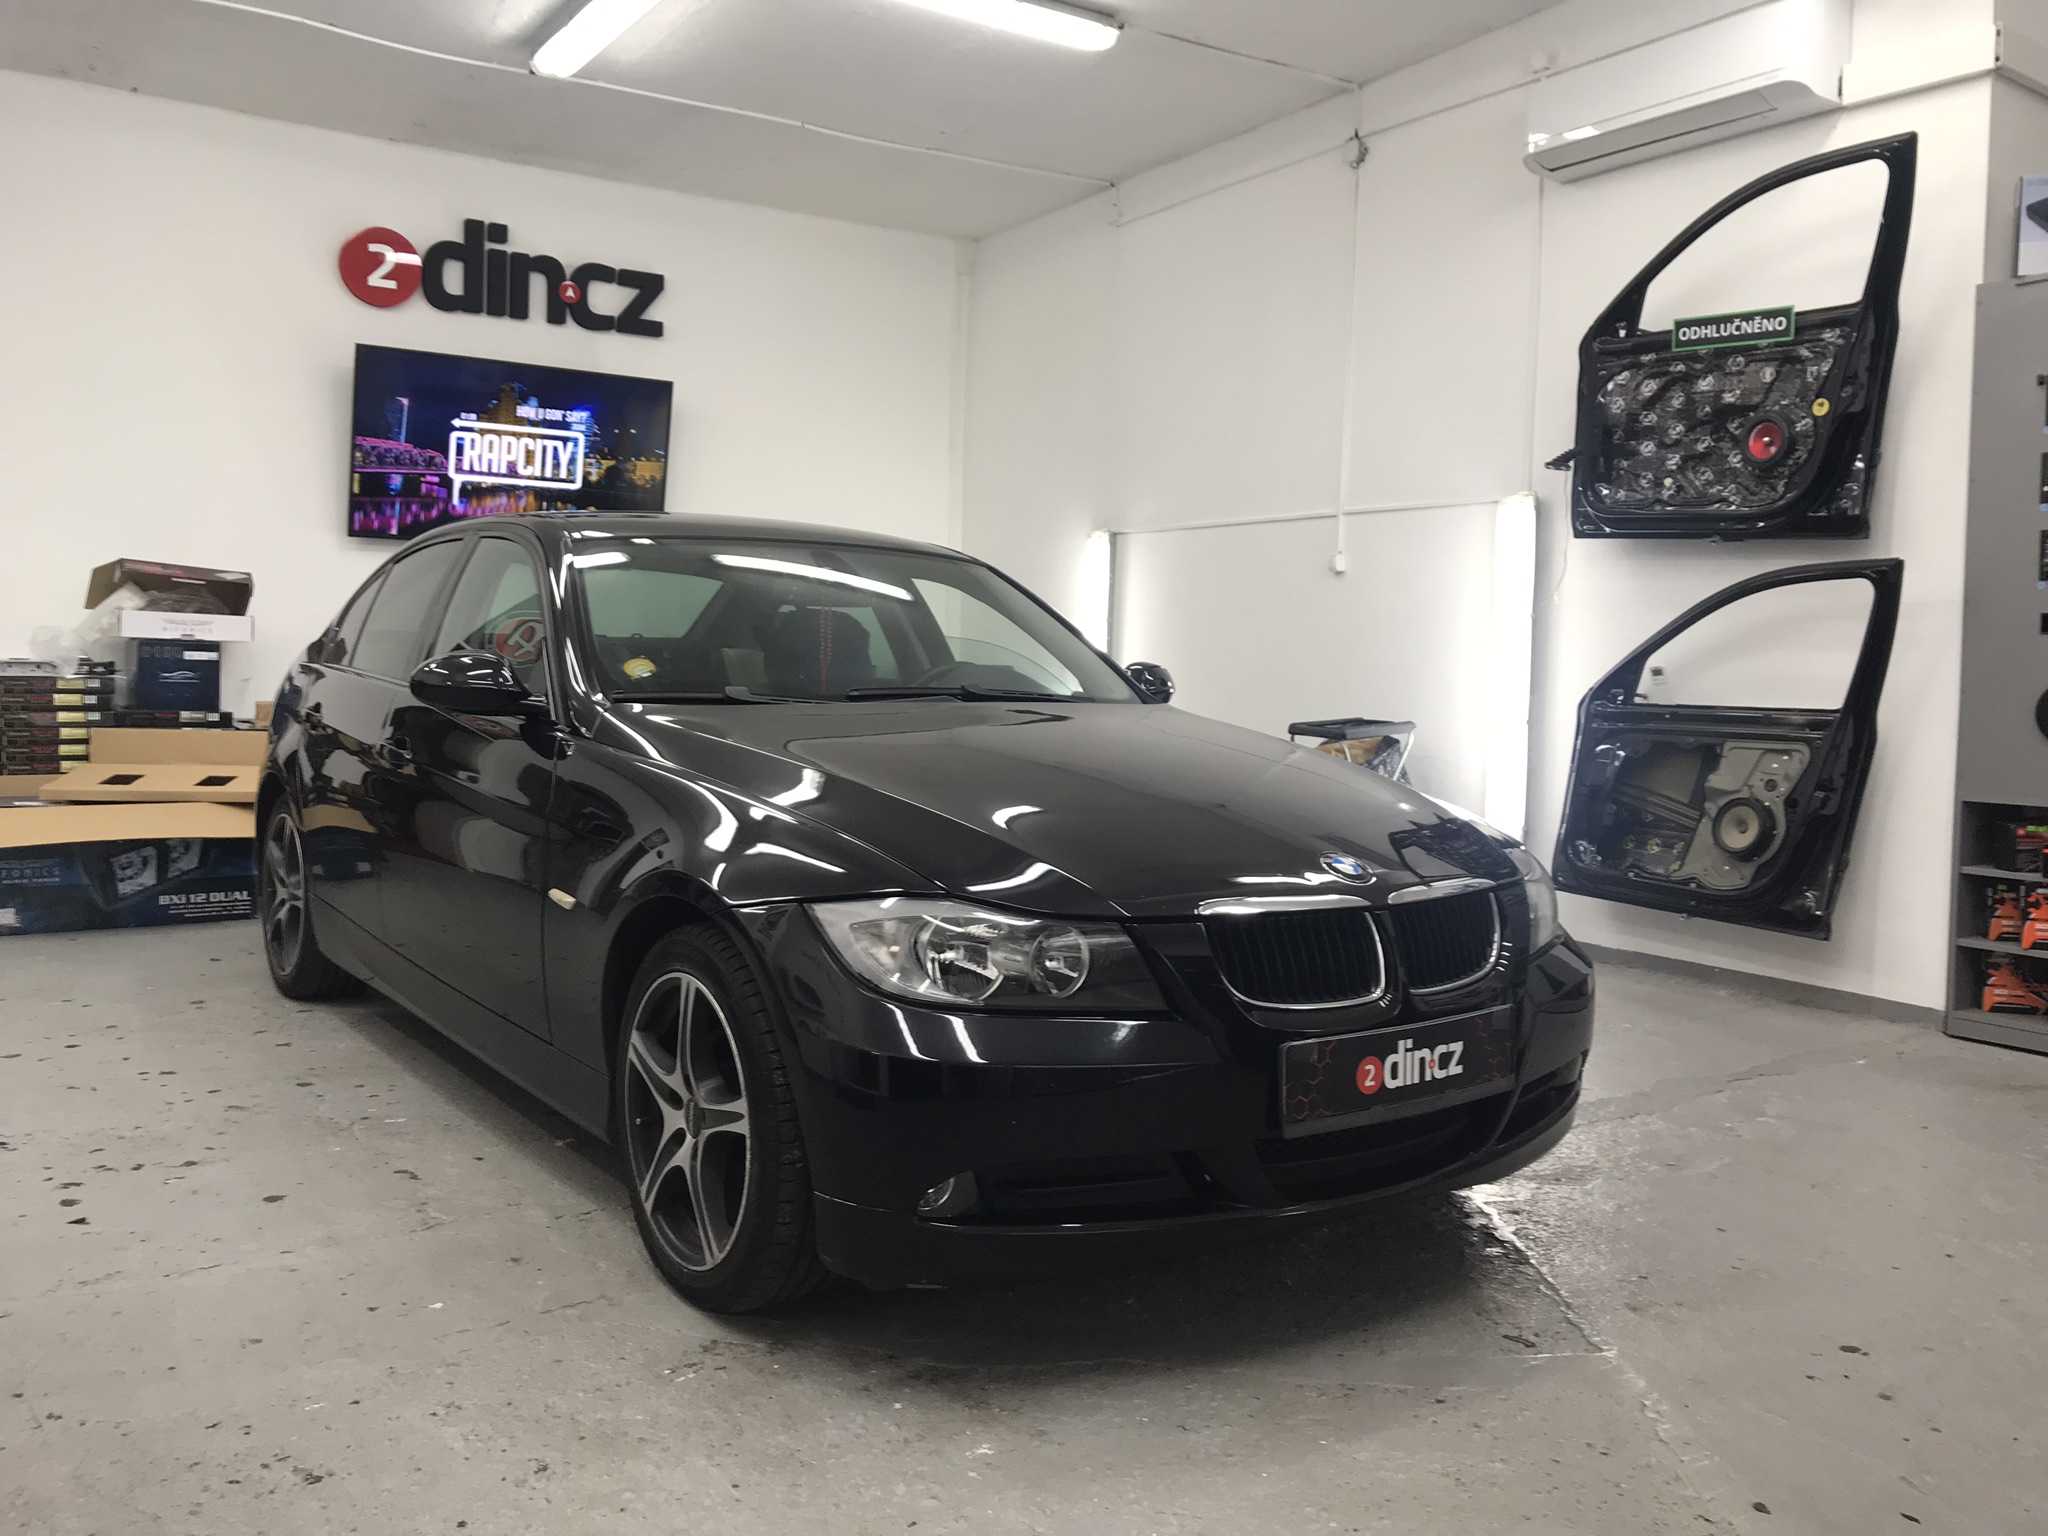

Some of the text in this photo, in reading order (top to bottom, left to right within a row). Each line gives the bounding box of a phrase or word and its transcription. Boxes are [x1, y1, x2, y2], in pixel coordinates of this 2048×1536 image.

[1678, 315, 1788, 341] ODHLUČNĚNO
[462, 431, 575, 479] RAPCITY
[209, 890, 252, 902] DUAL
